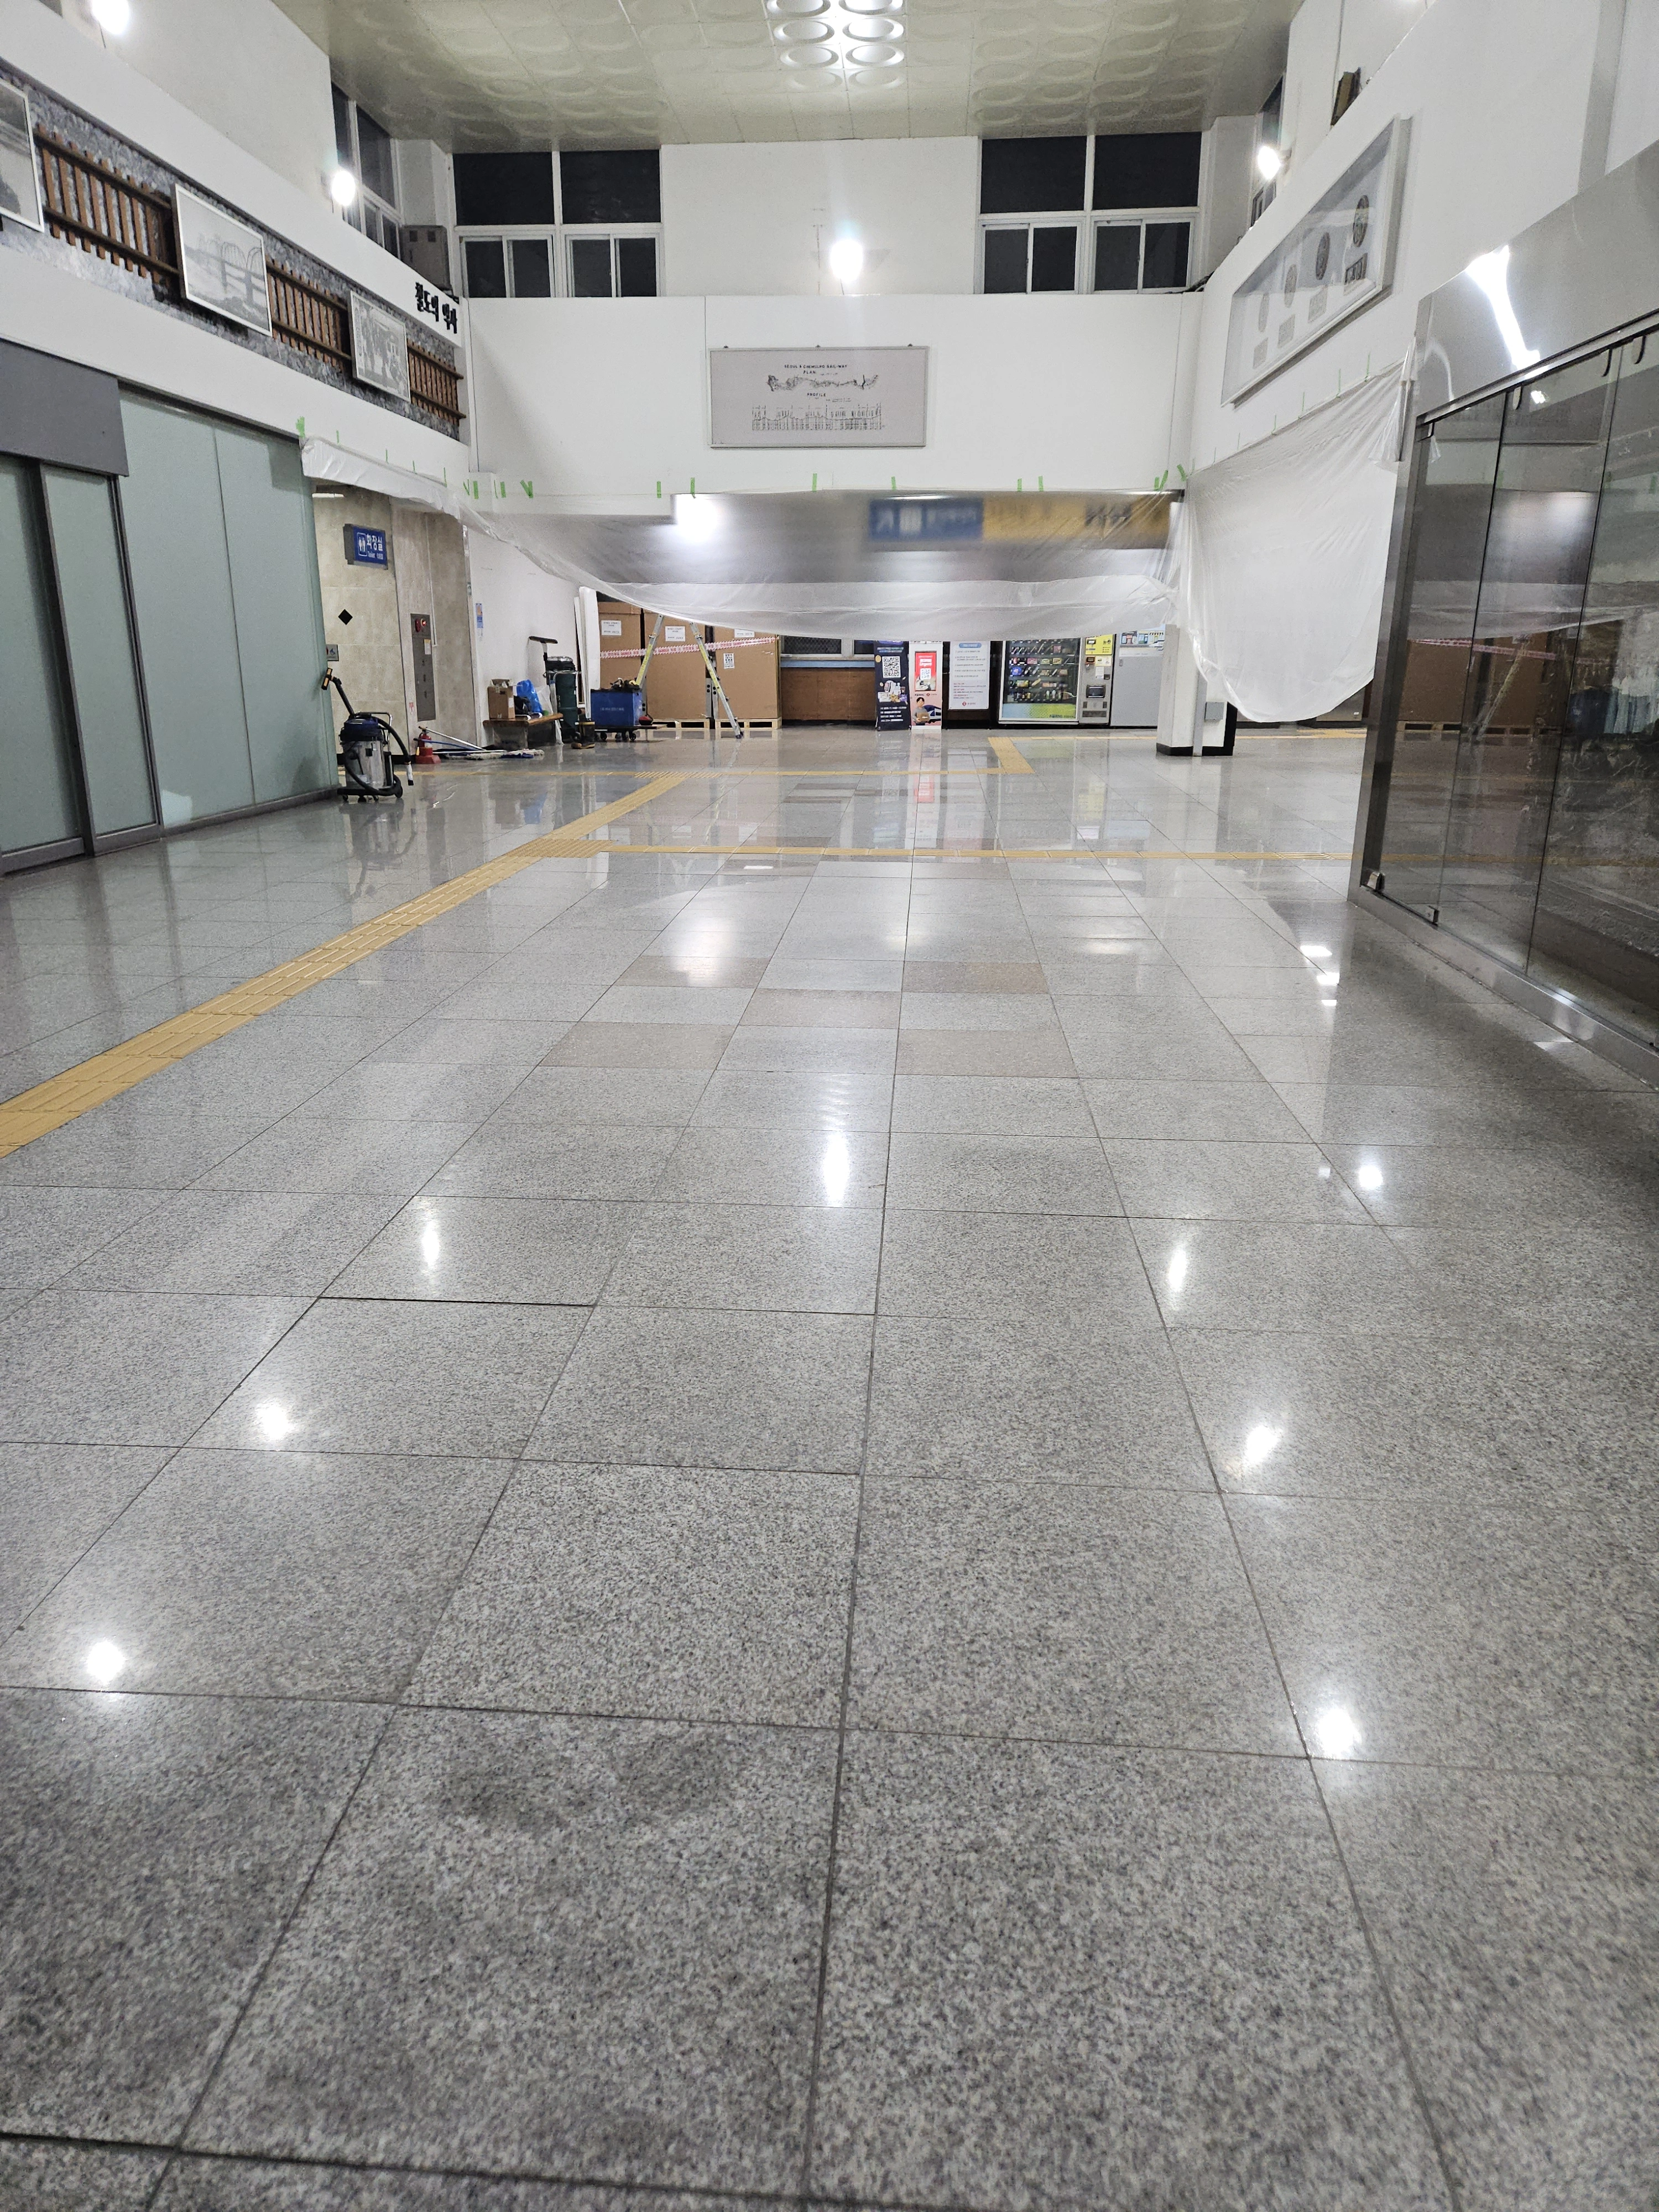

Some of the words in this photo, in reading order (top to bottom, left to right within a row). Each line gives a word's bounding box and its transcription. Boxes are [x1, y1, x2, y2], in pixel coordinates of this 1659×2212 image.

[415, 281, 439, 322] 철도의
[442, 303, 457, 334] 역사
[366, 533, 383, 551] 화장실
